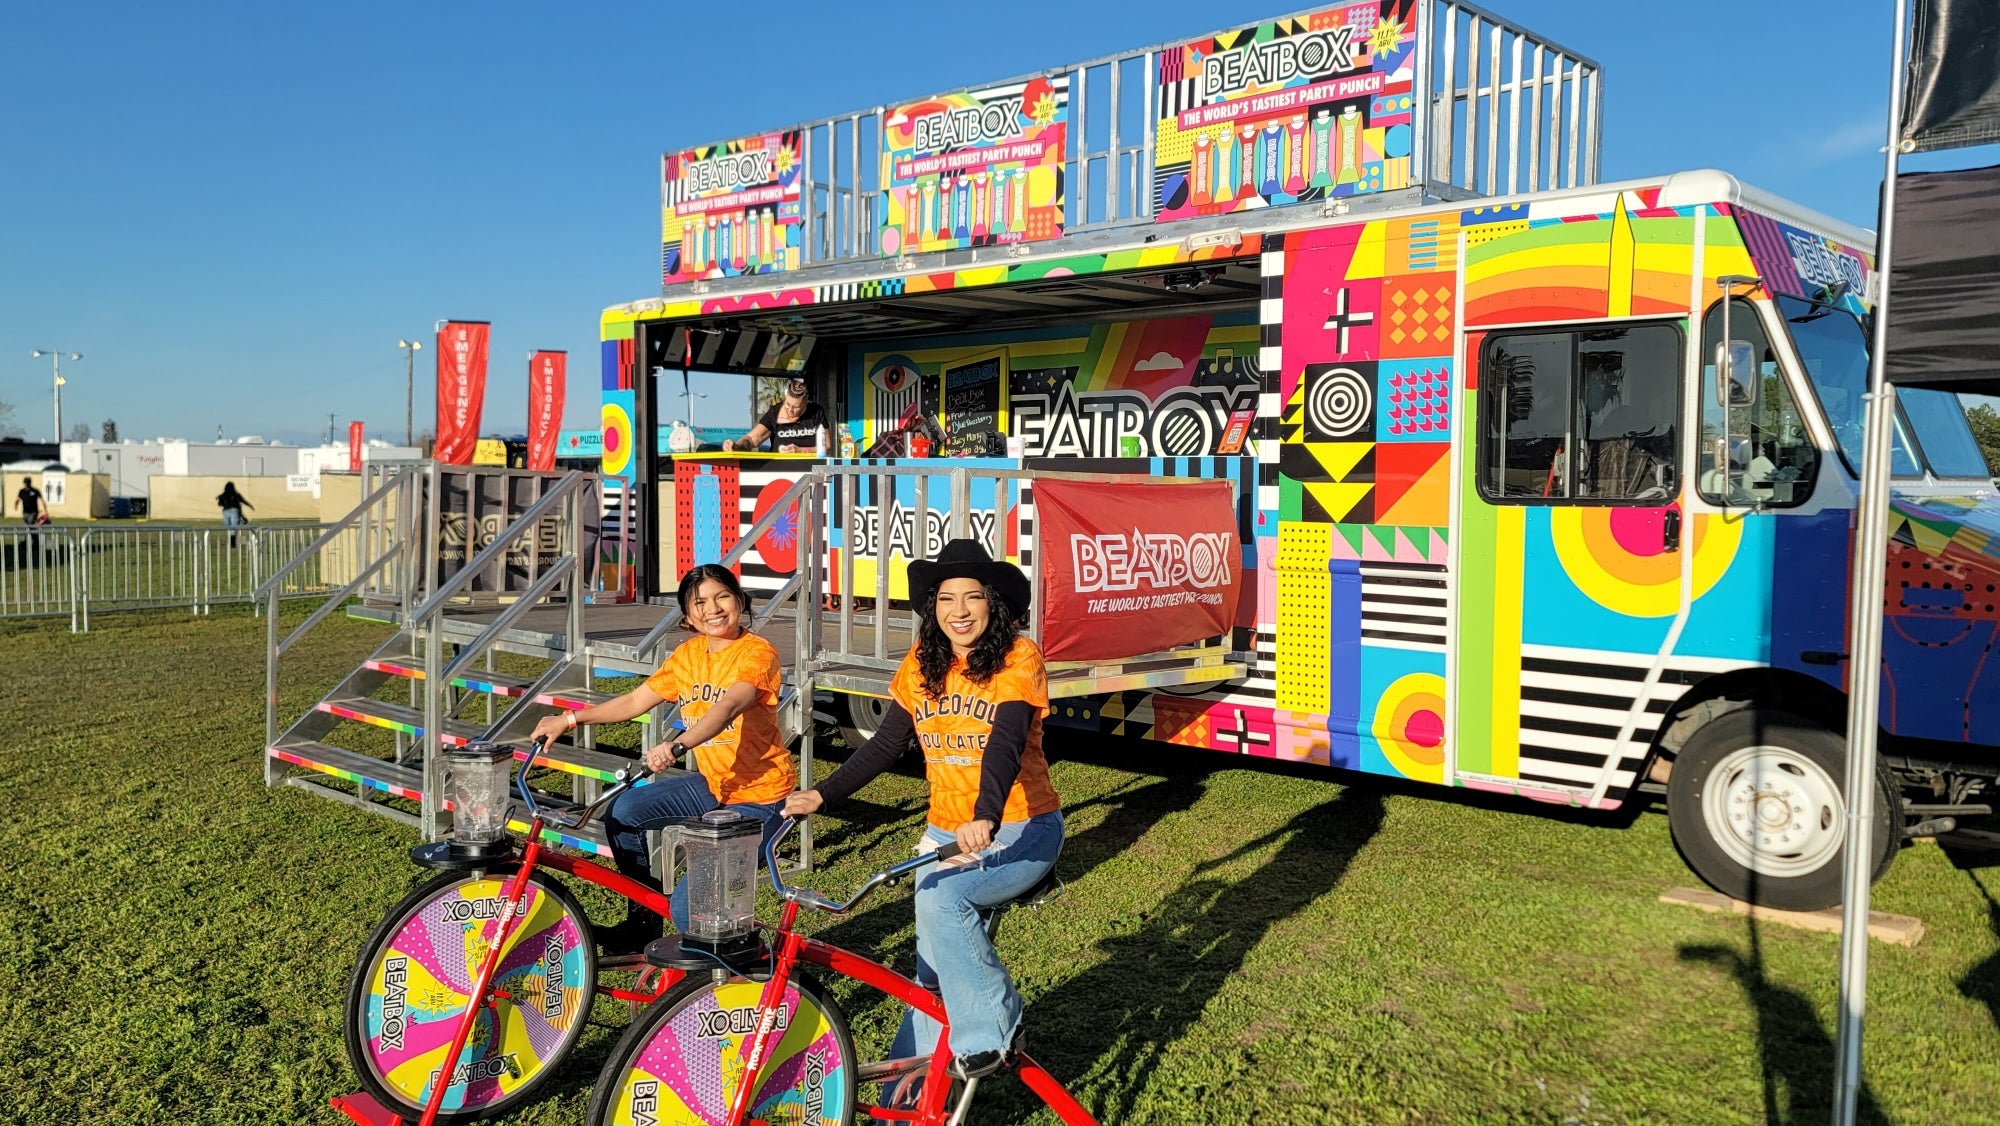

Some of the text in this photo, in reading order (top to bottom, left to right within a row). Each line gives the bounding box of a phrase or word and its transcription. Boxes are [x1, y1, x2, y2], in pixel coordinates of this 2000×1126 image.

[1377, 28, 1396, 40] 11.1%
[1378, 38, 1391, 48] ABV
[1205, 29, 1353, 95] BEATBOX
[1183, 76, 1380, 126] THE WORLD'S TASTIEST PARTY PUNCH
[915, 100, 1022, 152] BEATBOX
[690, 151, 768, 194] BEATBOX
[900, 142, 1042, 176] THE WORLD'S TASTIEST PARTY PUNCH
[677, 188, 783, 214] THE WORLD'S TASTIEST PARTY PUNCH
[455, 330, 468, 430] EMERGENCY
[540, 357, 554, 438] EMERGENCY
[1010, 382, 1259, 457] EATBOX
[1070, 526, 1232, 593] BEATBOX
[1088, 599, 1107, 614] THE
[1108, 595, 1150, 612] WORLD'S
[1150, 592, 1186, 608] TASTIEST
[679, 683, 727, 707] ACOH
[915, 693, 996, 726] ALCOHOL
[946, 734, 989, 750] LATE
[442, 895, 526, 922] BATBOX
[502, 900, 518, 922] BIKE
[544, 933, 565, 1018] BEATBOX
[381, 957, 407, 1053] BEATBOX
[698, 1004, 788, 1038] BATBOX
[763, 1008, 777, 1034] BIKE
[430, 1053, 517, 1091] BATBO
[804, 1050, 825, 1126] ATBOX
[633, 1081, 659, 1126] BEA
